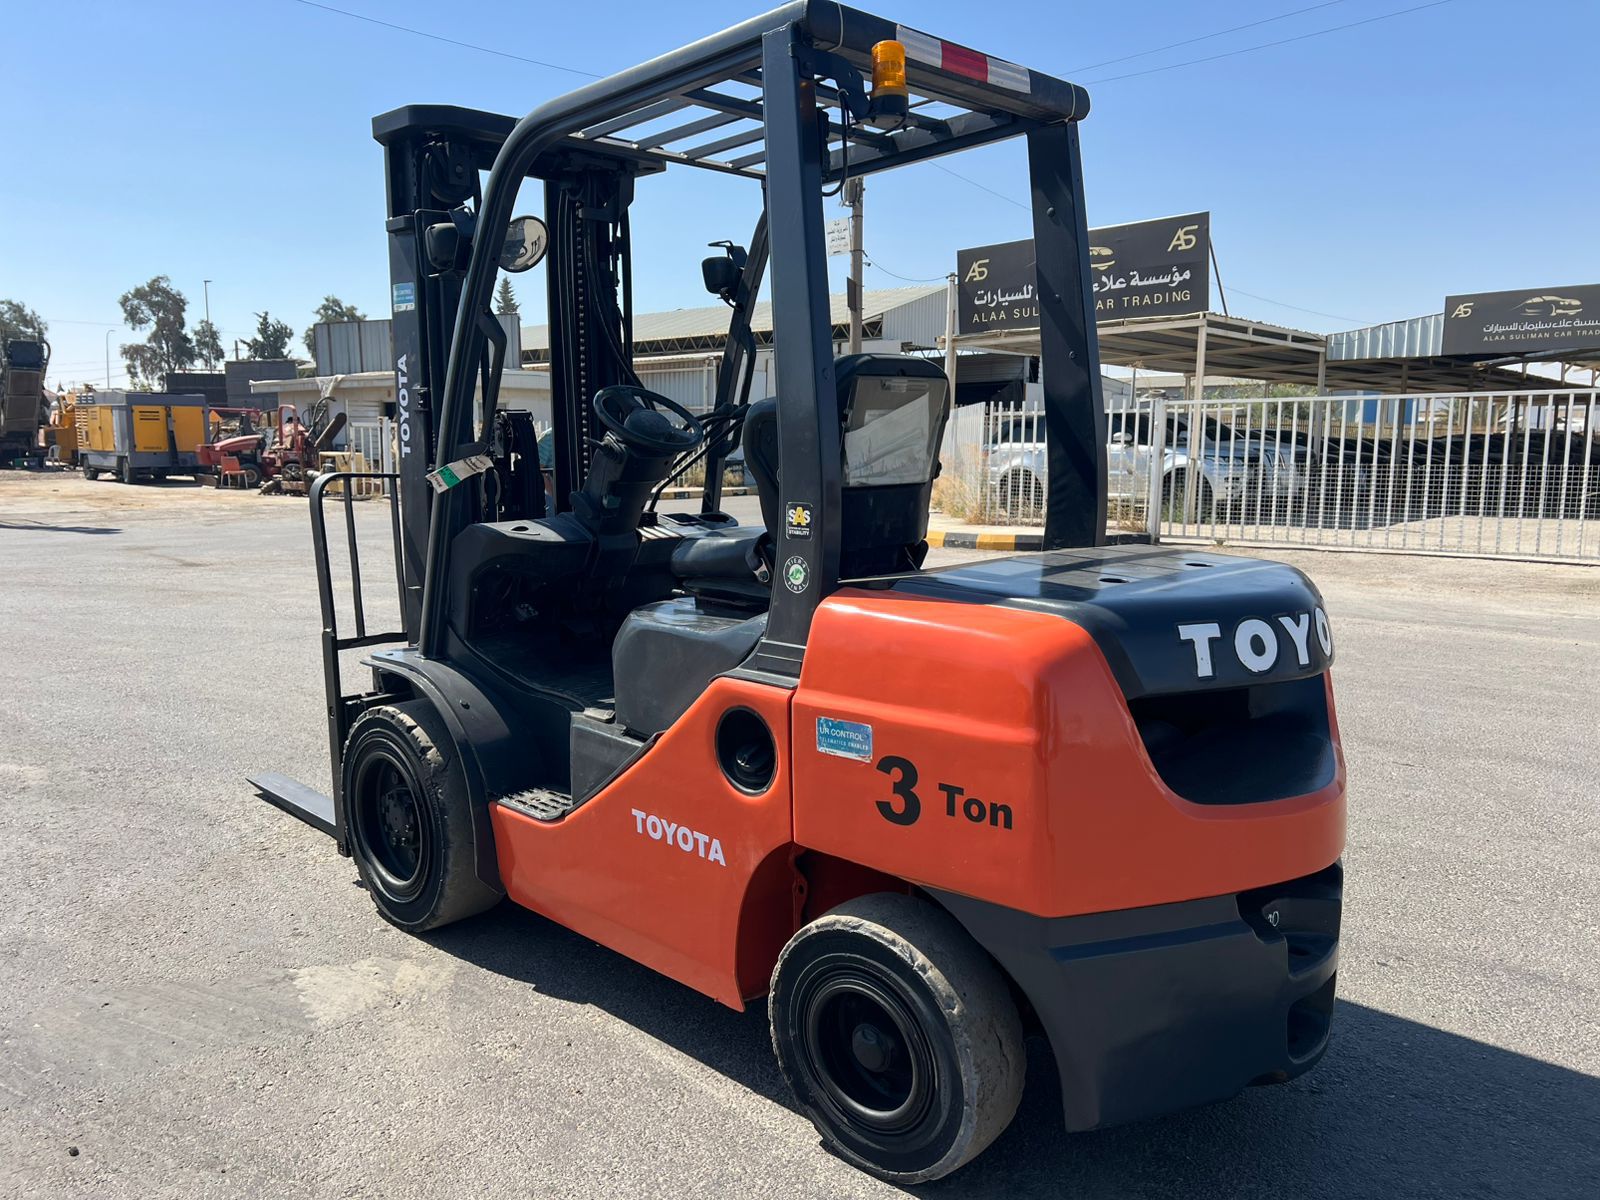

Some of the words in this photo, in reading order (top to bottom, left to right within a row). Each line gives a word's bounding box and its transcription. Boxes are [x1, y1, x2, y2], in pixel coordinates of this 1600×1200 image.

[1167, 225, 1198, 252] AS
[965, 259, 990, 282] AS
[1129, 265, 1191, 287] مؤسسة
[972, 310, 1006, 323] ALAA
[1096, 299, 1114, 311] AR
[1122, 290, 1191, 308] TRADING
[974, 284, 1033, 307] للسيارات
[1509, 332, 1550, 340] SULIMAN
[398, 354, 412, 458] TOYOTA
[788, 506, 811, 526] SAS
[1178, 608, 1332, 678] TOYO
[819, 727, 830, 736] UR
[830, 729, 865, 742] CONTROL
[875, 755, 921, 826] 3
[938, 783, 1013, 830] Ton
[631, 807, 727, 867] TOYOTA
